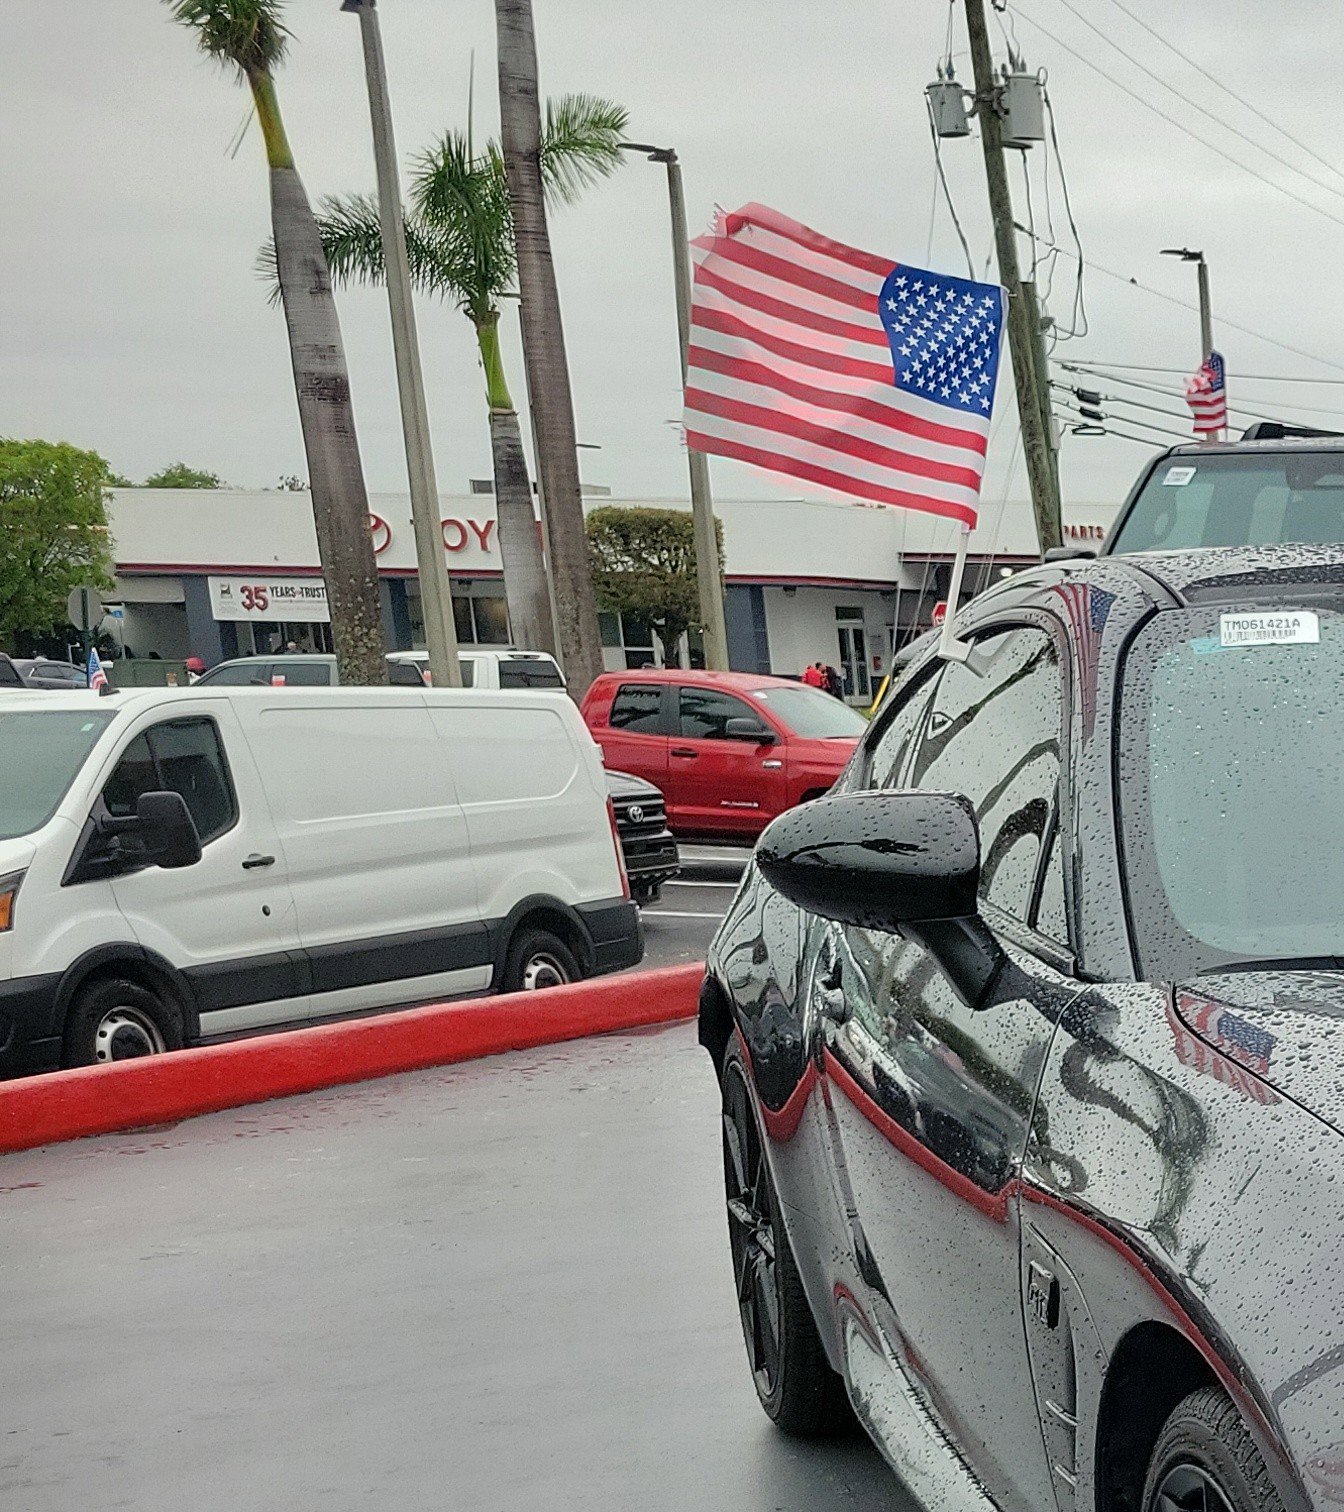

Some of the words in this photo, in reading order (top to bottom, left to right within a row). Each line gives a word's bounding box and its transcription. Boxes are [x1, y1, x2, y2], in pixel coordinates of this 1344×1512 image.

[240, 585, 269, 611] 35
[270, 586, 296, 599] YEARS
[300, 586, 326, 598] TRUST
